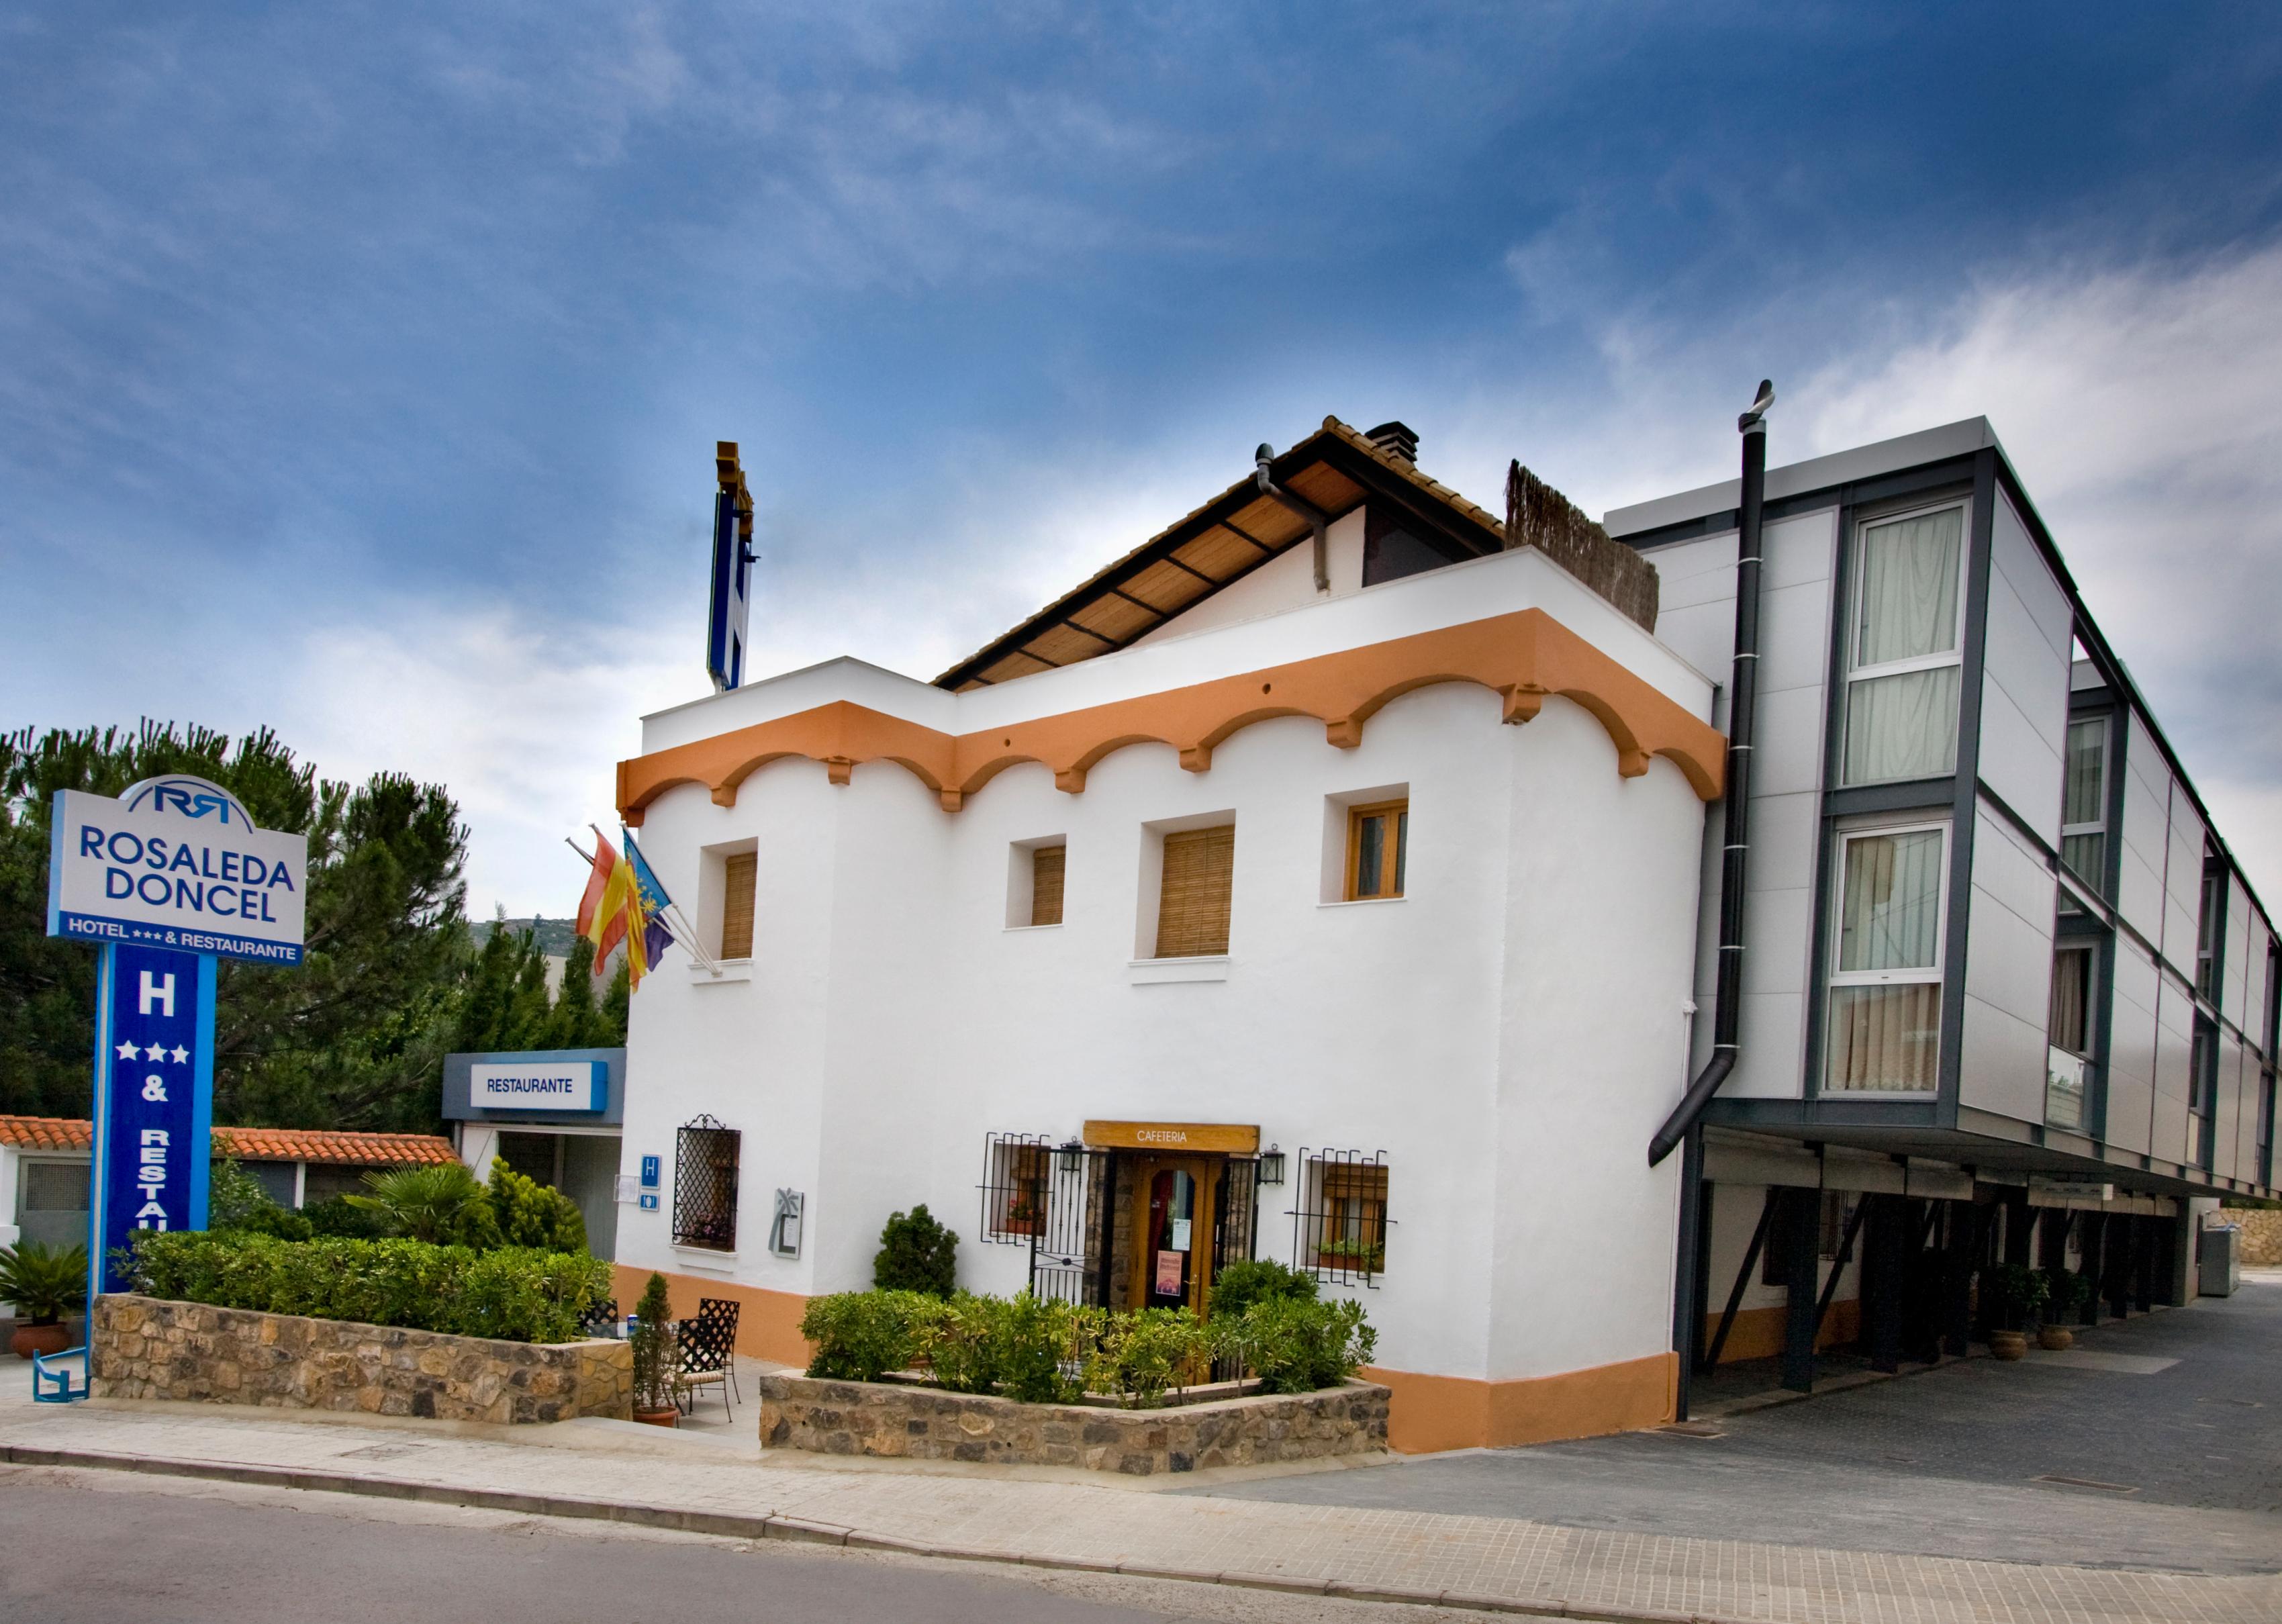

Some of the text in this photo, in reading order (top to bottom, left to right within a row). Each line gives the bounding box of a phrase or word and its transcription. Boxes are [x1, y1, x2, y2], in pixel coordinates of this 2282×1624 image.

[81, 825, 295, 892] ROSALEDA
[105, 867, 277, 922] DONCEL
[68, 918, 296, 960] HOTEL & RESTAURANTE
[139, 971, 175, 1016] H
[142, 1075, 169, 1102] &
[487, 1078, 573, 1092] RESTAURANTE
[1137, 1131, 1187, 1142] CAFETERIA
[645, 1158, 655, 1176] H
